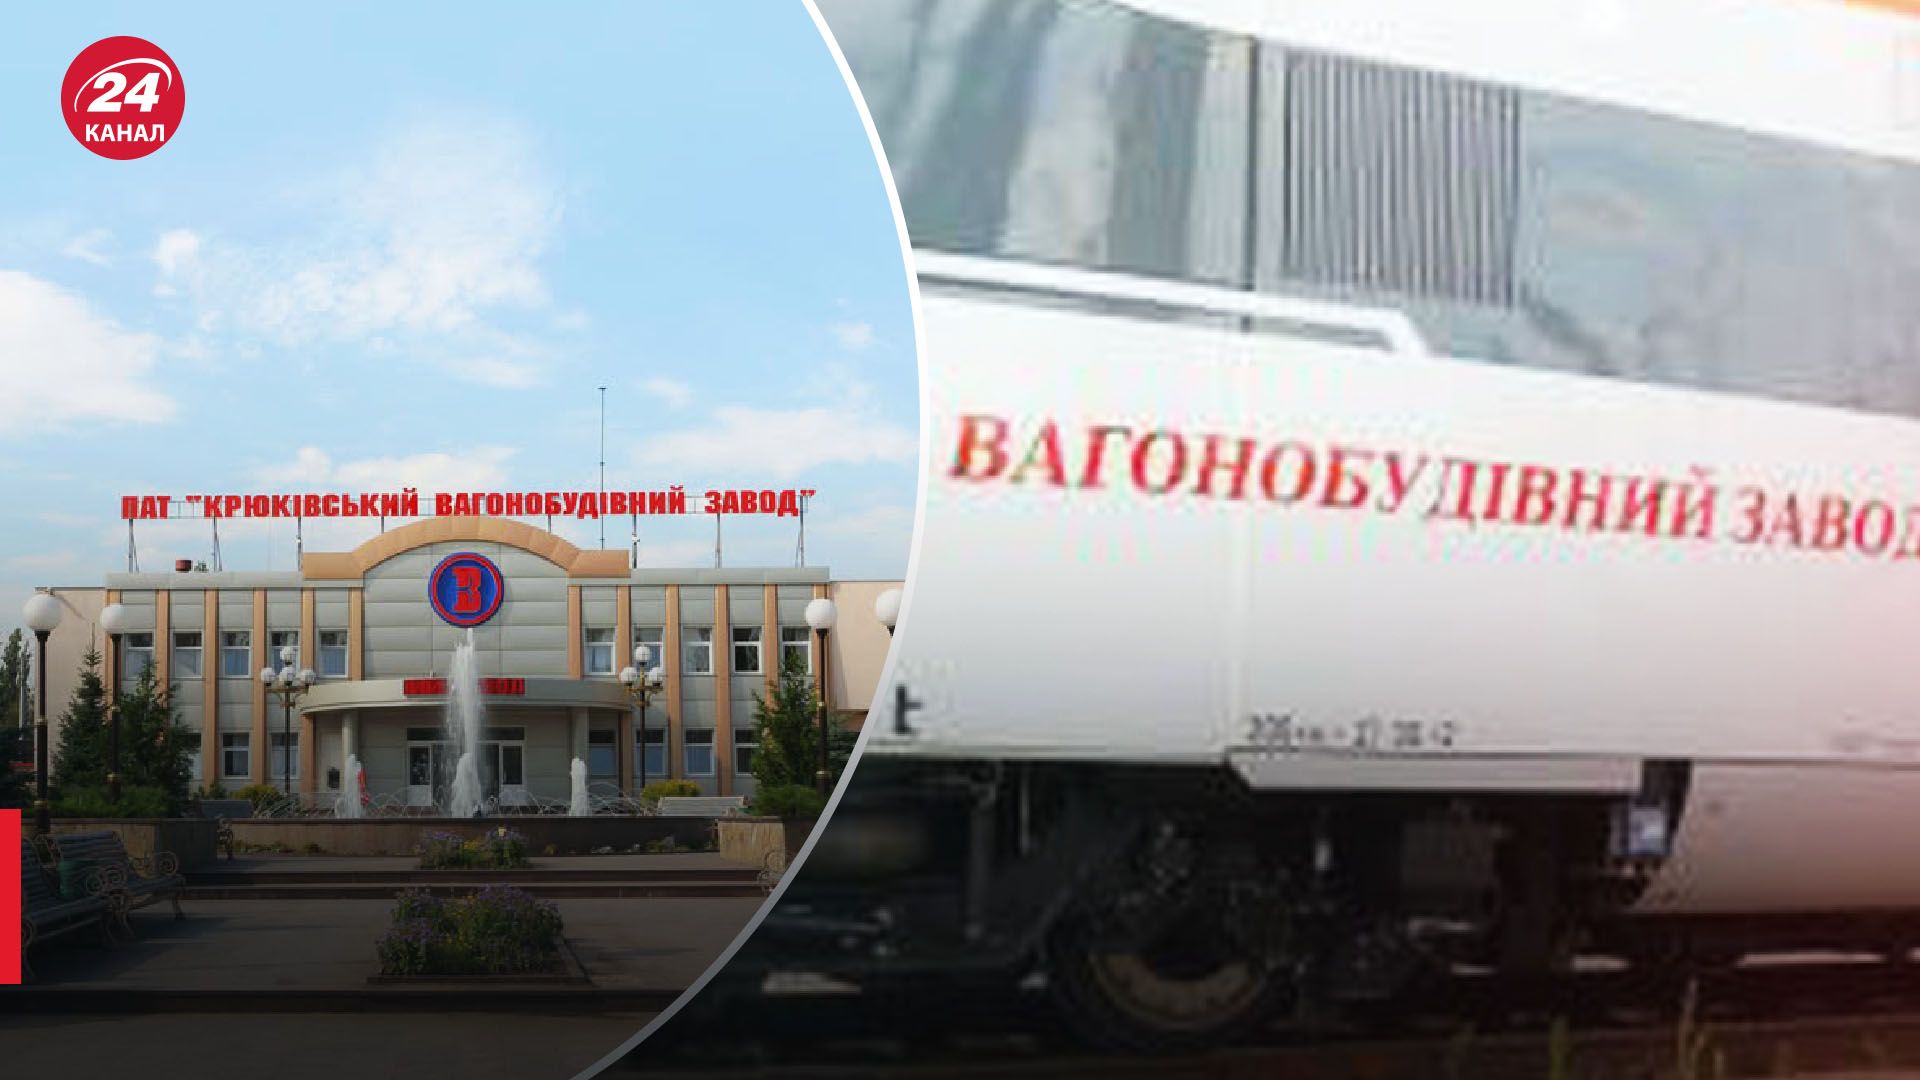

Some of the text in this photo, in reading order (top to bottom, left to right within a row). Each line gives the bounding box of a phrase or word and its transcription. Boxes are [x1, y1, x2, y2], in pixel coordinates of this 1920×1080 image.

[121, 495, 171, 519] ПАТ
[435, 485, 686, 519] ВАГОНОБУДІВНИЙ
[947, 412, 1719, 541] ВАГОНОБУДІВНИЙ
